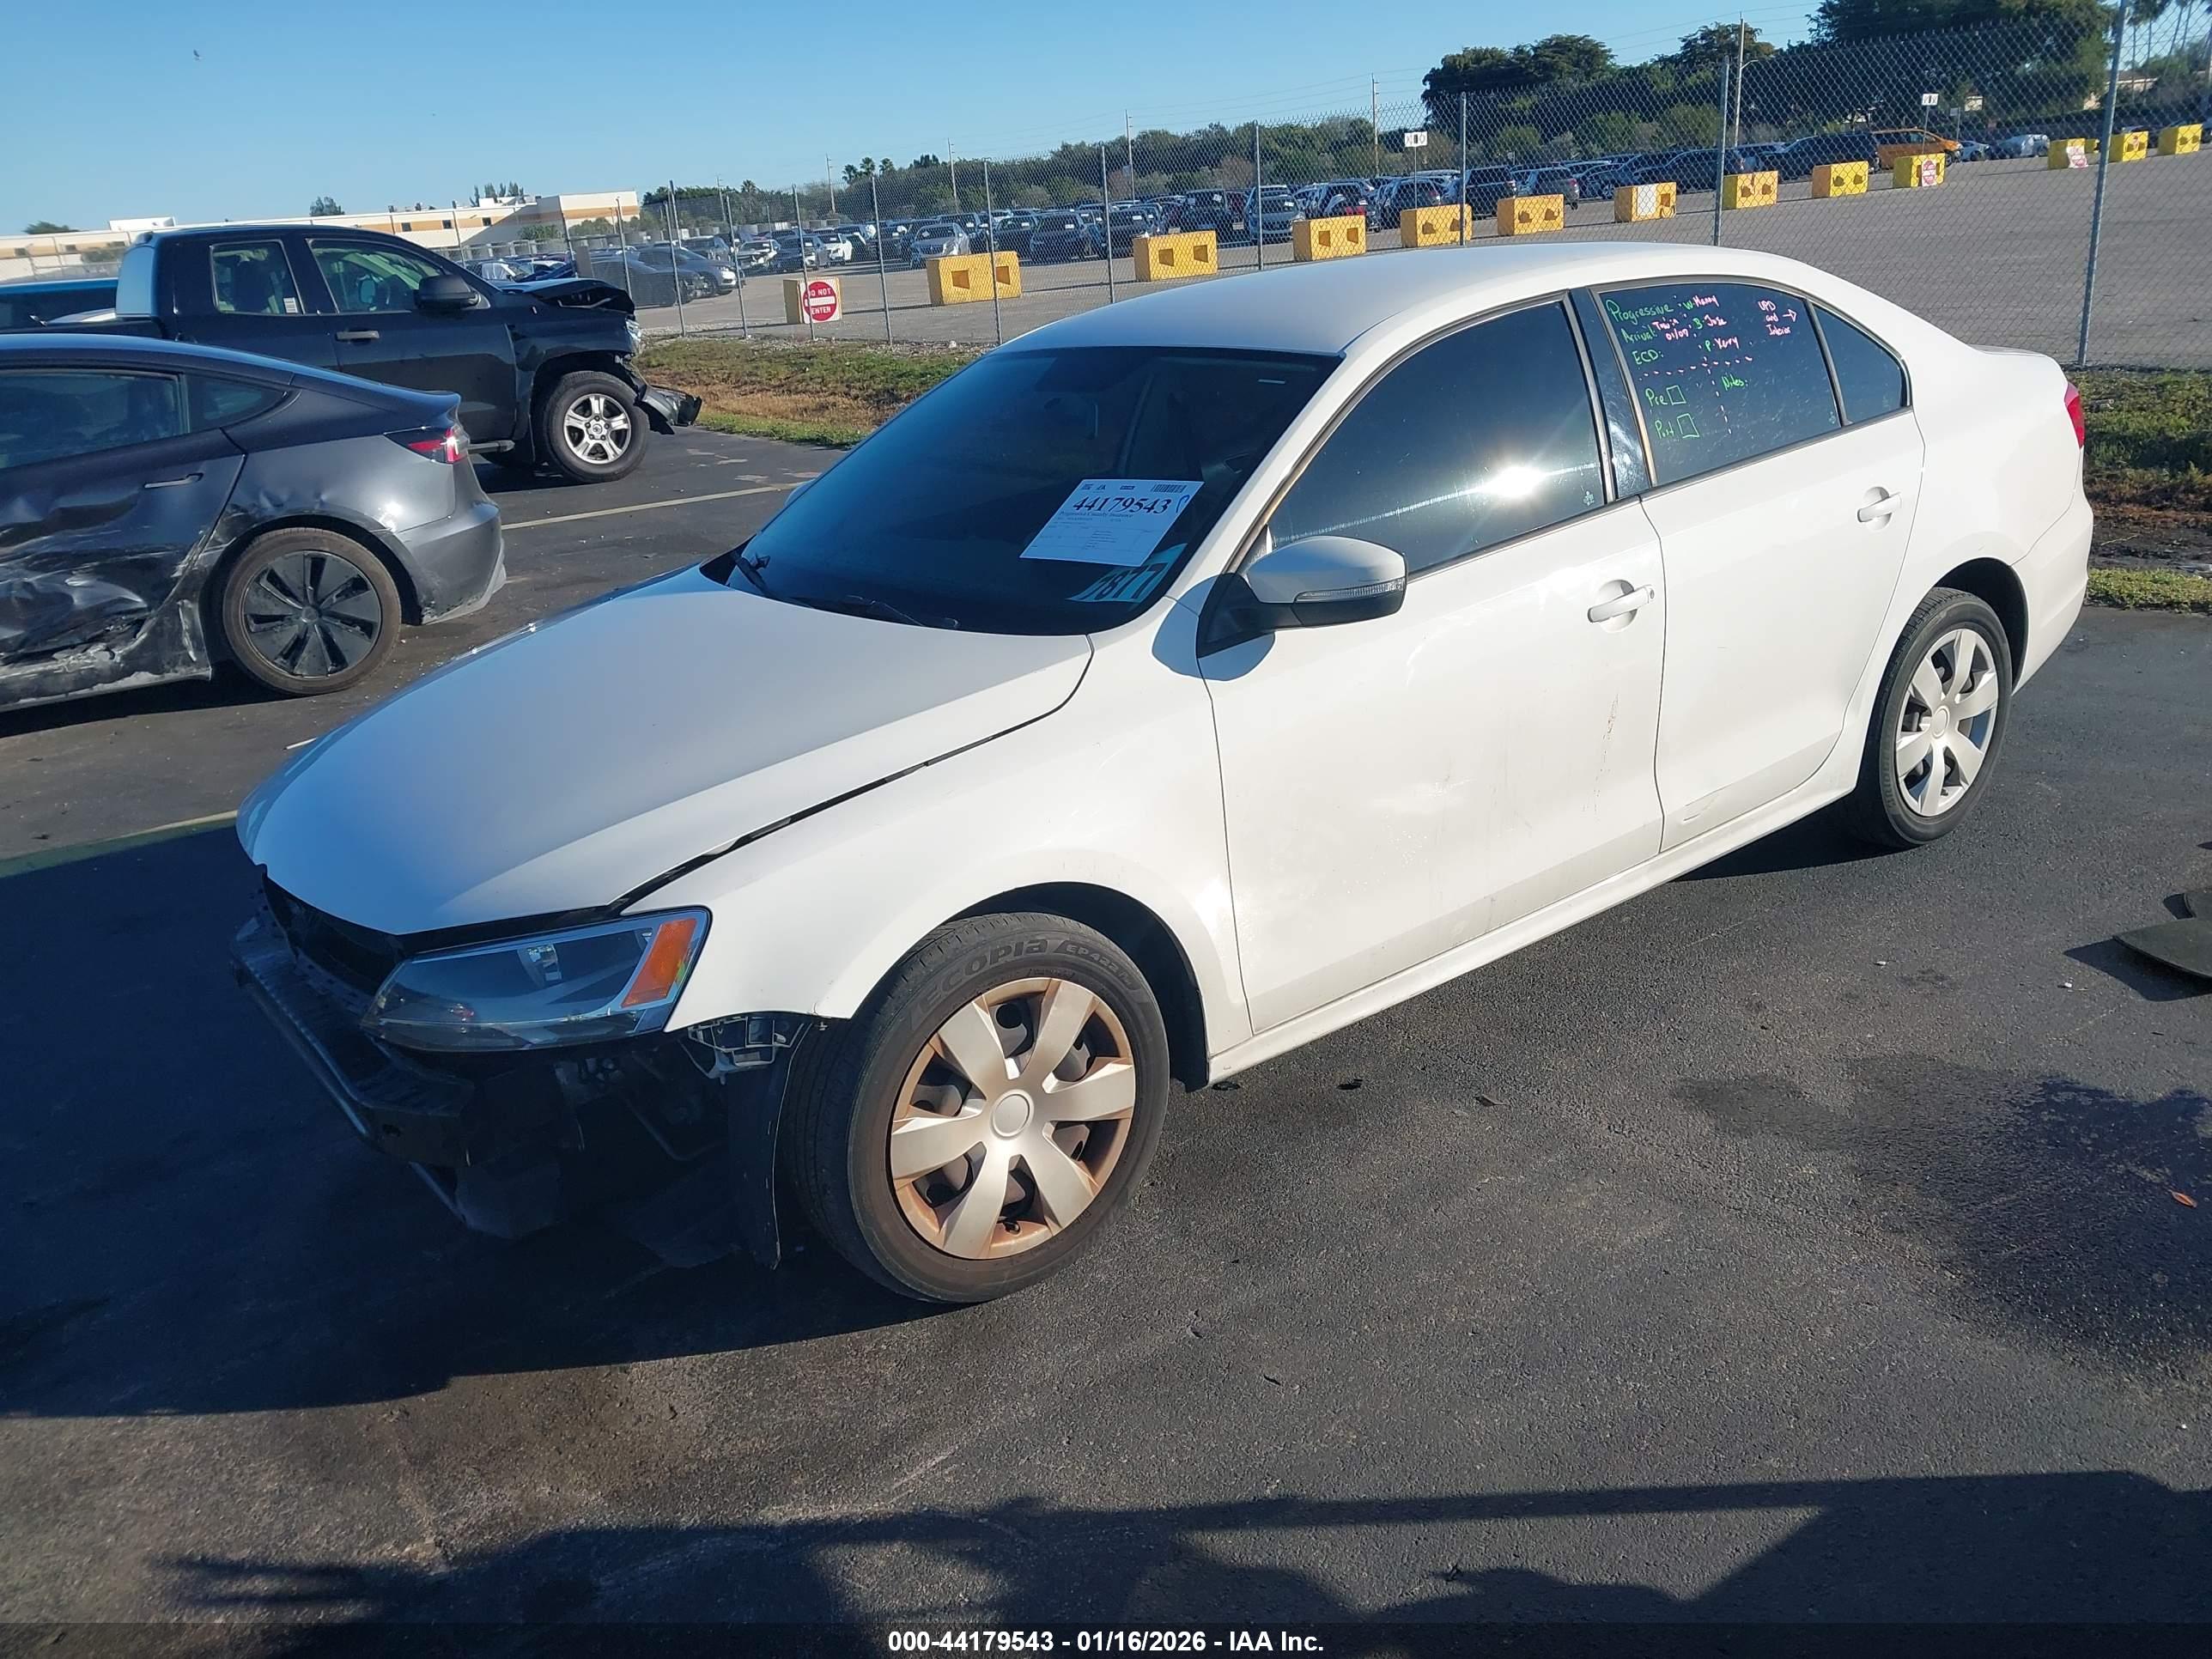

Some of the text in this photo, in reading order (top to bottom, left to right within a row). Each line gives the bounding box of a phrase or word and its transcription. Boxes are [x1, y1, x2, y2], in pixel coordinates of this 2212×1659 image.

[817, 288, 831, 296] NOT
[811, 306, 831, 315] ENTER
[1606, 300, 1674, 325] Progressive
[1765, 313, 1779, 322] and
[1632, 349, 1664, 364] ECD:
[1645, 388, 1668, 406] Pre
[1655, 420, 1674, 439] Post
[1072, 495, 1172, 514] 44179543
[1066, 944, 1090, 956] EP
[1090, 952, 1120, 974] 422
